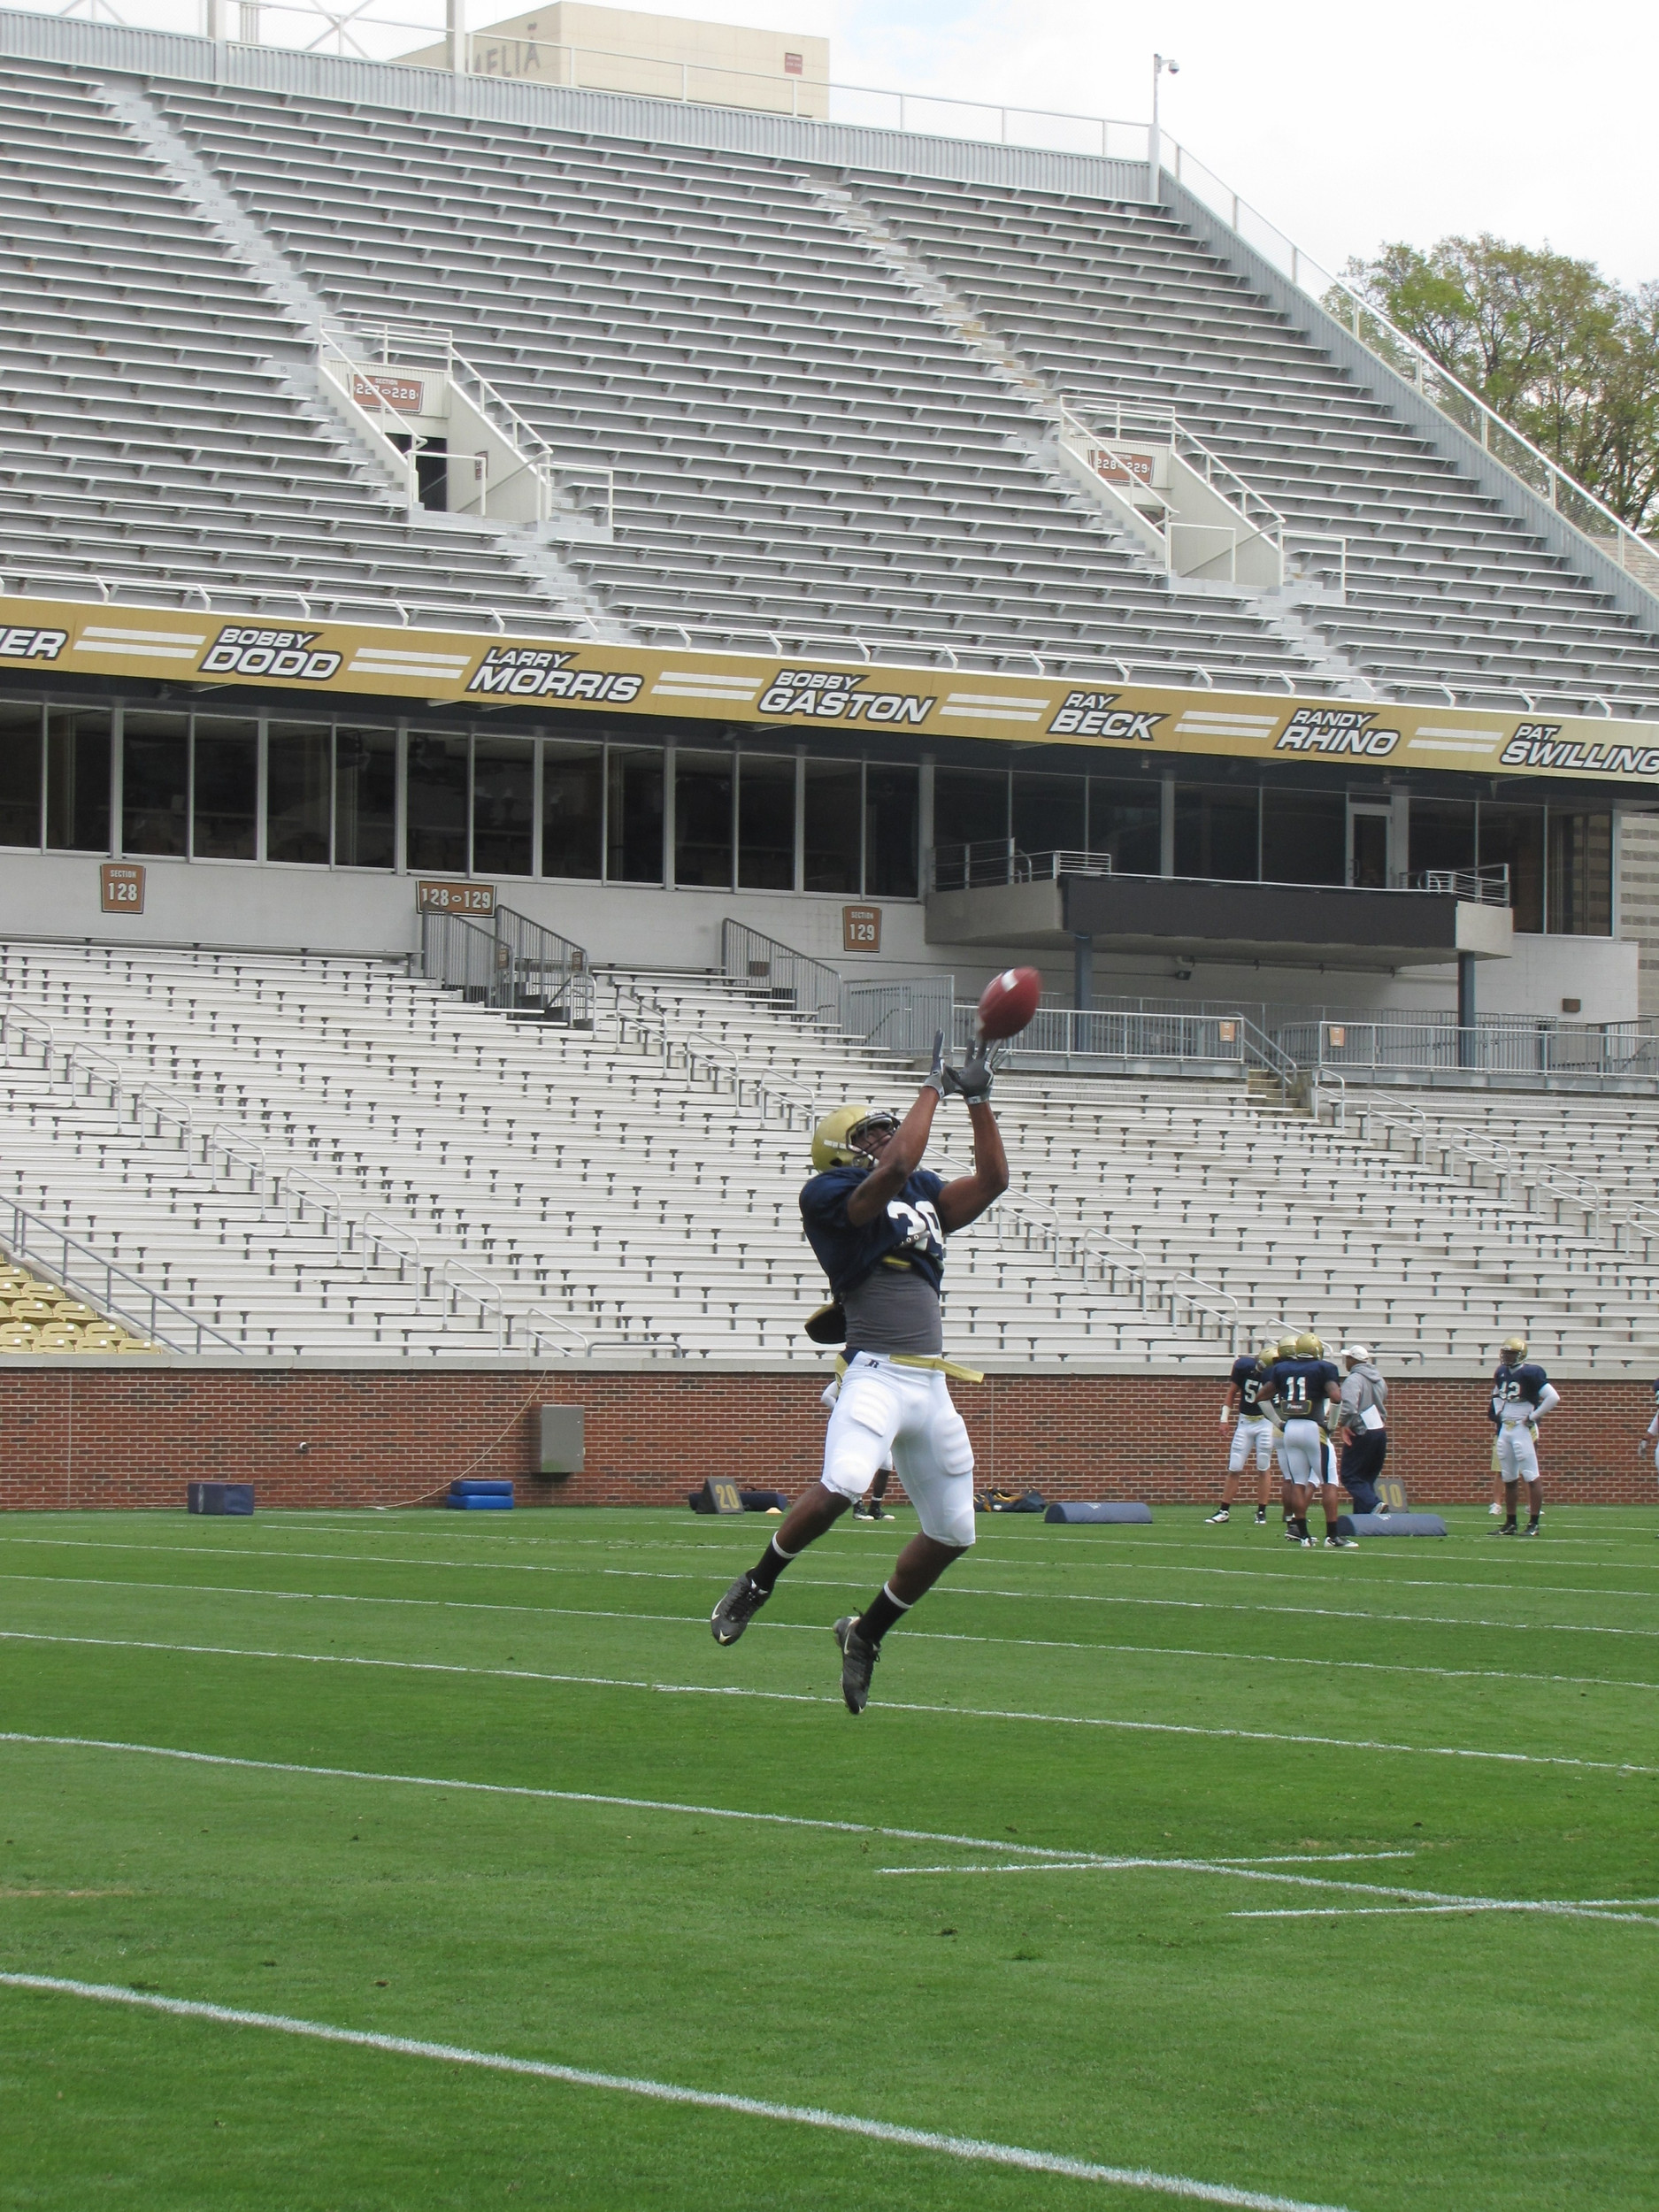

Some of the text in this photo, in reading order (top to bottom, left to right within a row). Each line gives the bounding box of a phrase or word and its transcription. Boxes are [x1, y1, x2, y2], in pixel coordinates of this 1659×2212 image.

[0, 626, 68, 660] ER
[218, 626, 319, 650] BOBBY
[201, 644, 342, 680] DODD
[483, 648, 575, 669] LARRY
[468, 665, 643, 702] MORRIS
[773, 671, 864, 691] BOBBY
[758, 687, 936, 724] GASTON
[1064, 692, 1117, 710] RAY
[1048, 708, 1164, 740] BECK
[1291, 709, 1374, 729] RANDY
[1275, 725, 1400, 756] RHINO
[1514, 725, 1560, 741] PAT
[1500, 740, 1659, 773] SWILLING
[110, 870, 136, 879] SECTION
[108, 882, 138, 902] 128
[849, 923, 875, 941] 129
[1244, 1379, 1263, 1403] 5
[1286, 1376, 1306, 1401] 11
[715, 1484, 740, 1509] 20
[1378, 1483, 1403, 1508] 10
